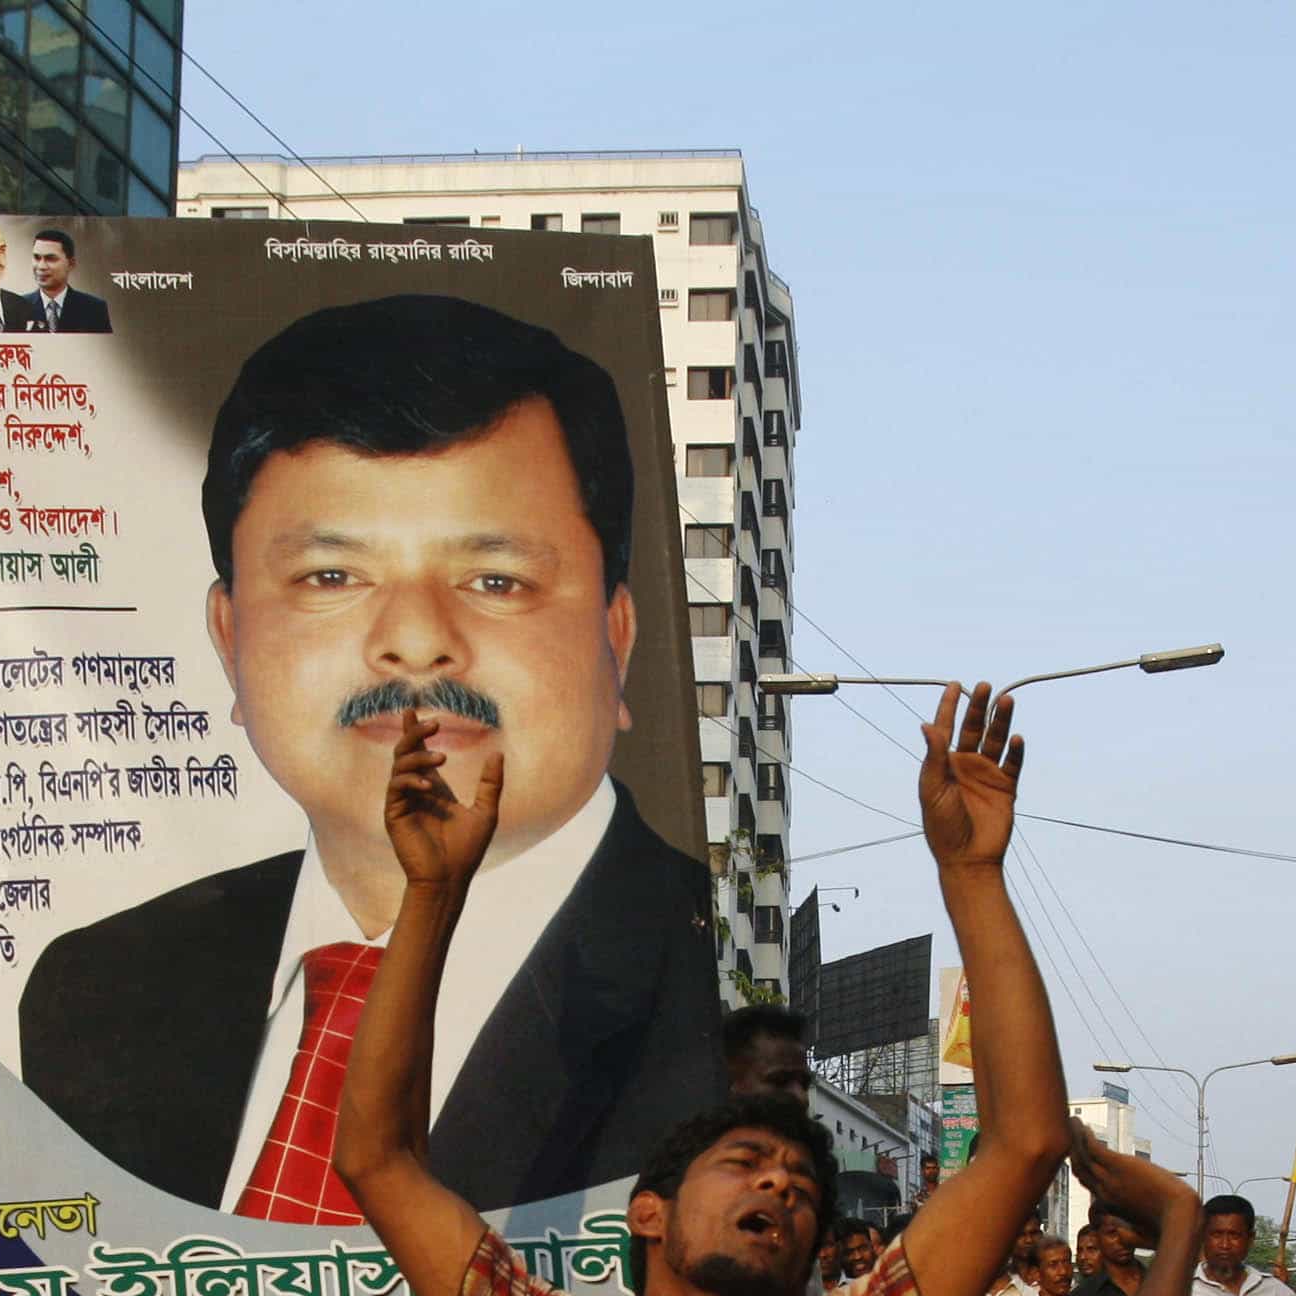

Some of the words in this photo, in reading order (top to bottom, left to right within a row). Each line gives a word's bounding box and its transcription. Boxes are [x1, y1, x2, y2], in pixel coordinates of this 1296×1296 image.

[447, 239, 494, 263] রাহিম
[111, 270, 193, 290] বাংলাদেশ
[561, 267, 634, 289] জিন্দাবাদ
[12, 374, 96, 418] নির্বাসিত,
[4, 414, 92, 458] নিরুদ্দেশ,
[49, 542, 100, 583] আলী
[72, 651, 176, 693] গণমানুষের
[76, 700, 136, 745] সাহসী
[143, 701, 210, 743] সৈনিক
[126, 755, 180, 797] জাতীয়
[186, 755, 239, 799] নির্বাহী
[71, 818, 142, 854] সম্পাদক
